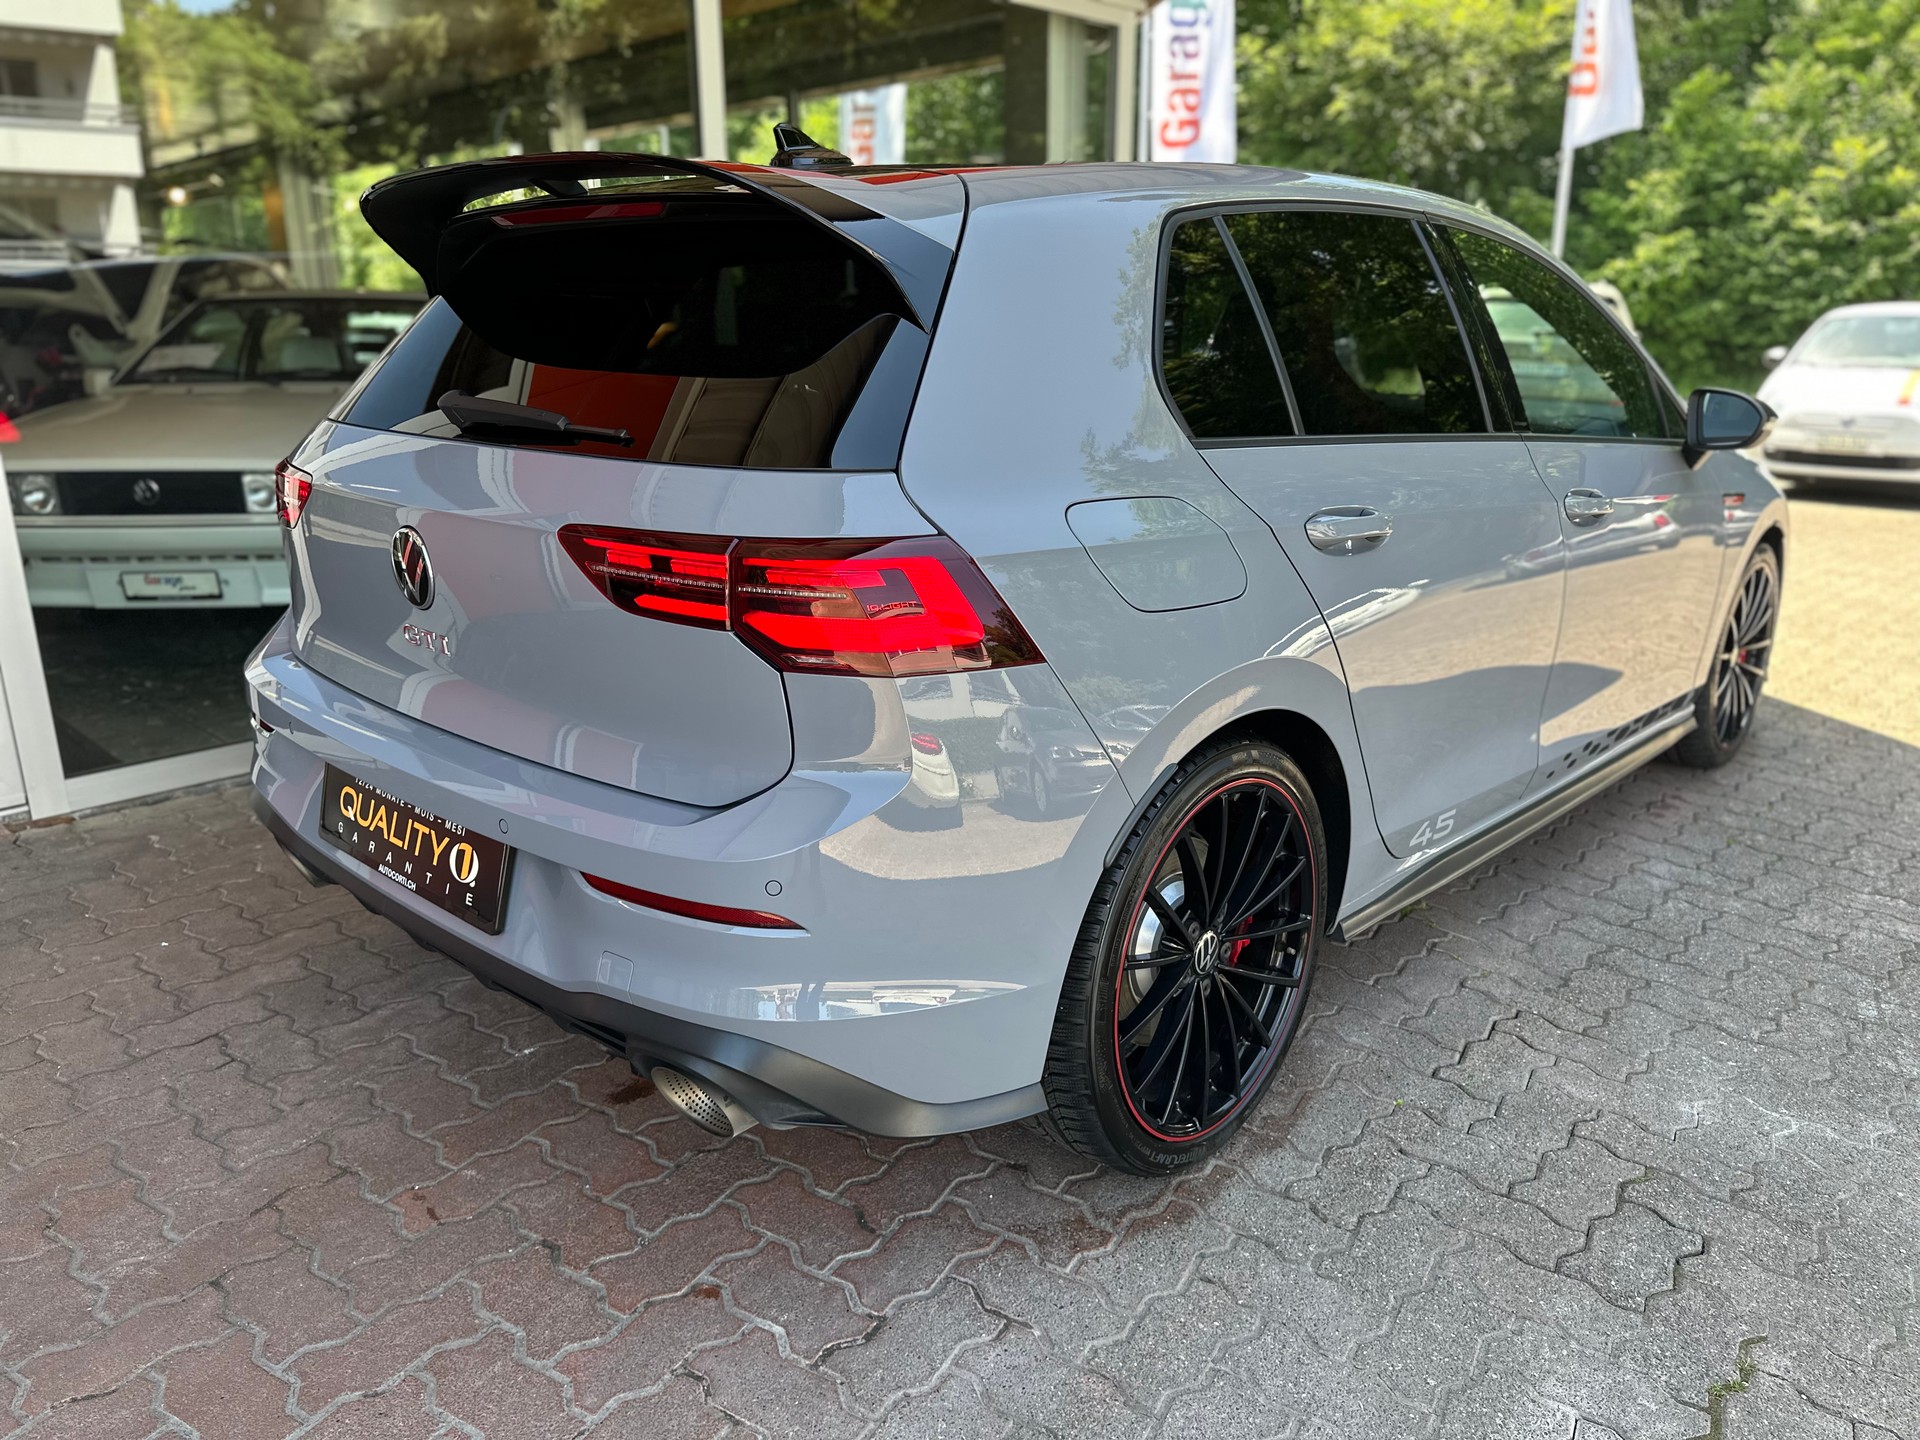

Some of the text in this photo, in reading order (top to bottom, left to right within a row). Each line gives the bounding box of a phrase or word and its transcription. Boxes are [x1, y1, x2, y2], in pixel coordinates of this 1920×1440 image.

[403, 623, 451, 657] GTI
[339, 786, 450, 866] QUALITY
[444, 819, 466, 837] MESI
[1409, 808, 1457, 847] 45
[337, 821, 473, 906] GARANTIE
